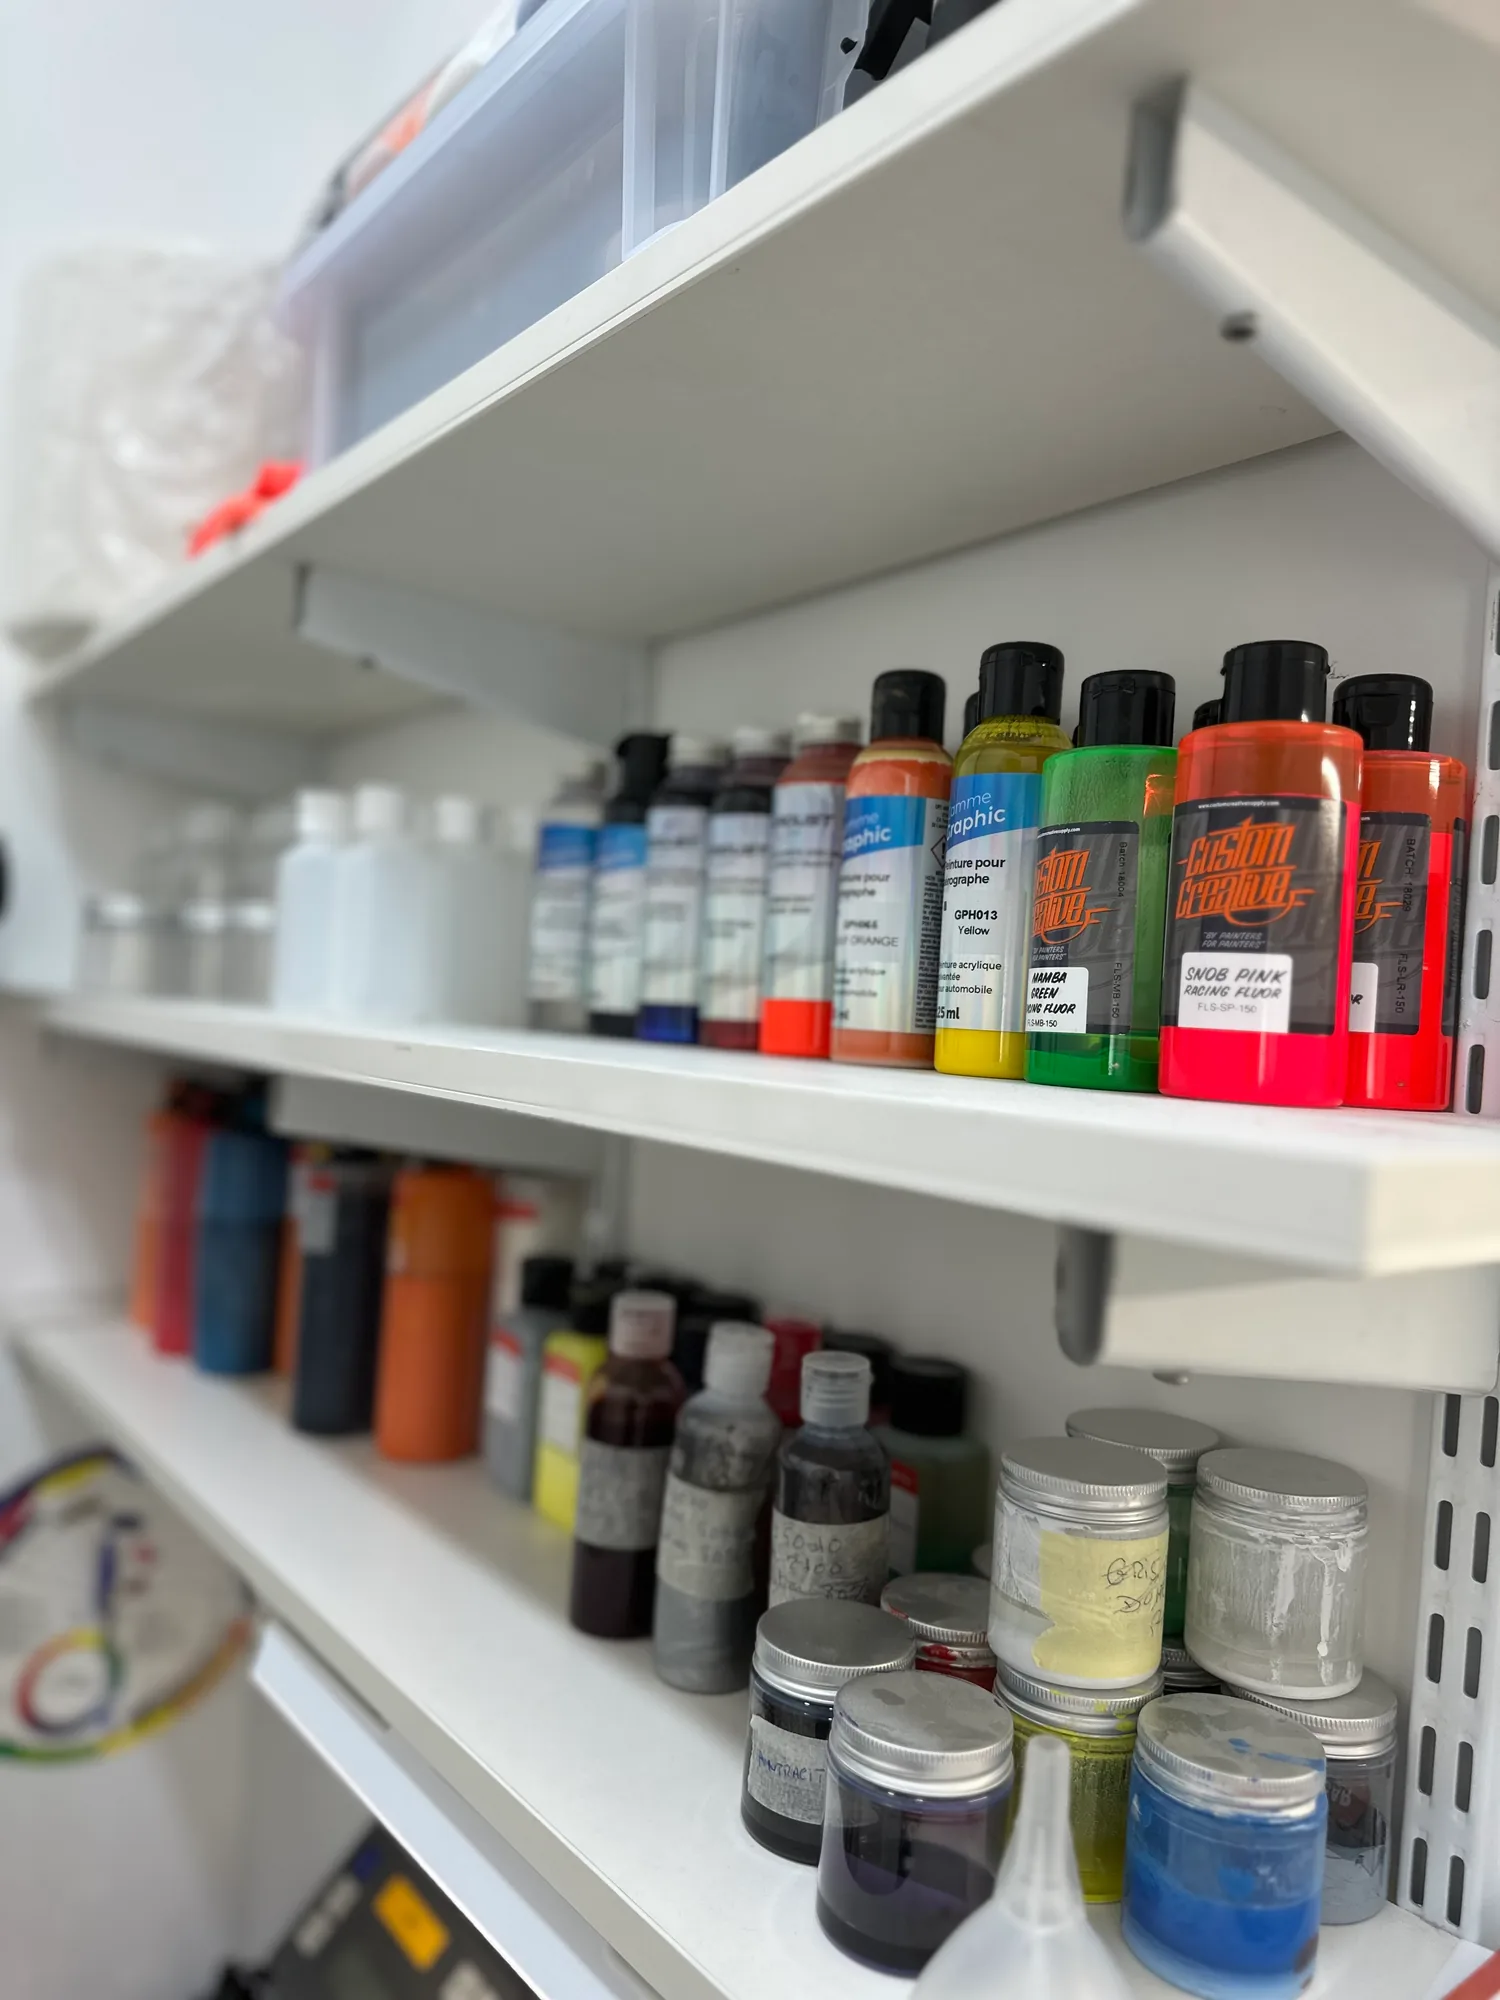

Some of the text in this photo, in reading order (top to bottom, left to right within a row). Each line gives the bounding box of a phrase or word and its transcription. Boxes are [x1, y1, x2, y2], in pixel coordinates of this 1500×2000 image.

[1177, 814, 1297, 878] Custom
[945, 859, 1006, 870] einture pour
[1175, 868, 1312, 920] Creative
[954, 909, 998, 921] GPH013
[958, 926, 991, 936] Yellow
[958, 961, 1002, 971] acrylique
[1032, 972, 1067, 983] MAMBA
[1185, 967, 1287, 984] SNOB PINK
[945, 984, 993, 995] automobile
[1031, 987, 1059, 999] GREEN
[1184, 985, 1282, 999] RACING FLUOR
[946, 1007, 960, 1019] ml
[1043, 1003, 1076, 1015] FLUOR
[1197, 1002, 1257, 1013] FLS-SP-150
